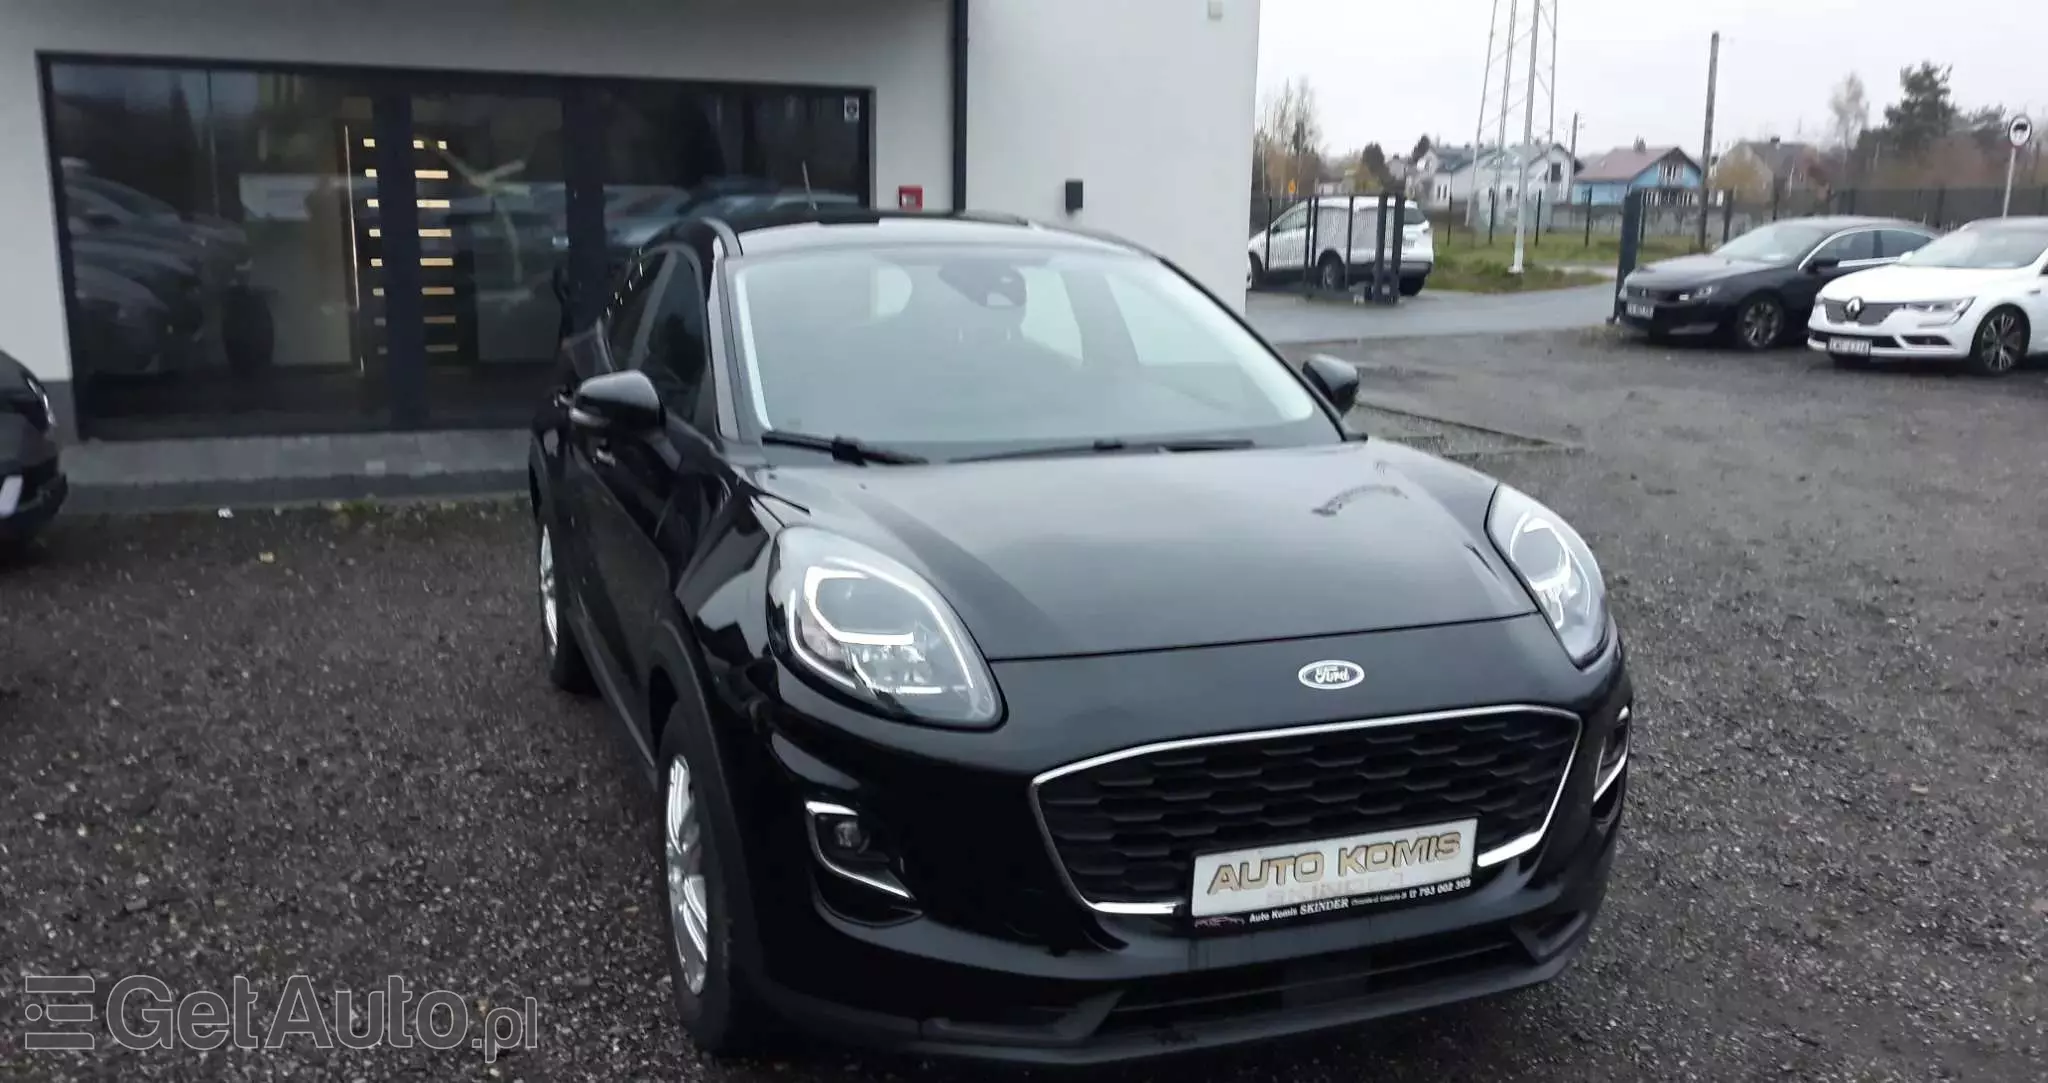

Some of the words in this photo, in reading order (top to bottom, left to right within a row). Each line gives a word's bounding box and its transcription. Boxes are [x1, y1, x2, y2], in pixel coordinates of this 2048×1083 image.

[1315, 664, 1350, 684] Ford
[1206, 851, 1325, 895] AUTO
[1338, 831, 1462, 877] KOMIS
[1249, 911, 1270, 923] Auto
[1271, 907, 1298, 919] Komis
[1300, 897, 1349, 916] SKINDER
